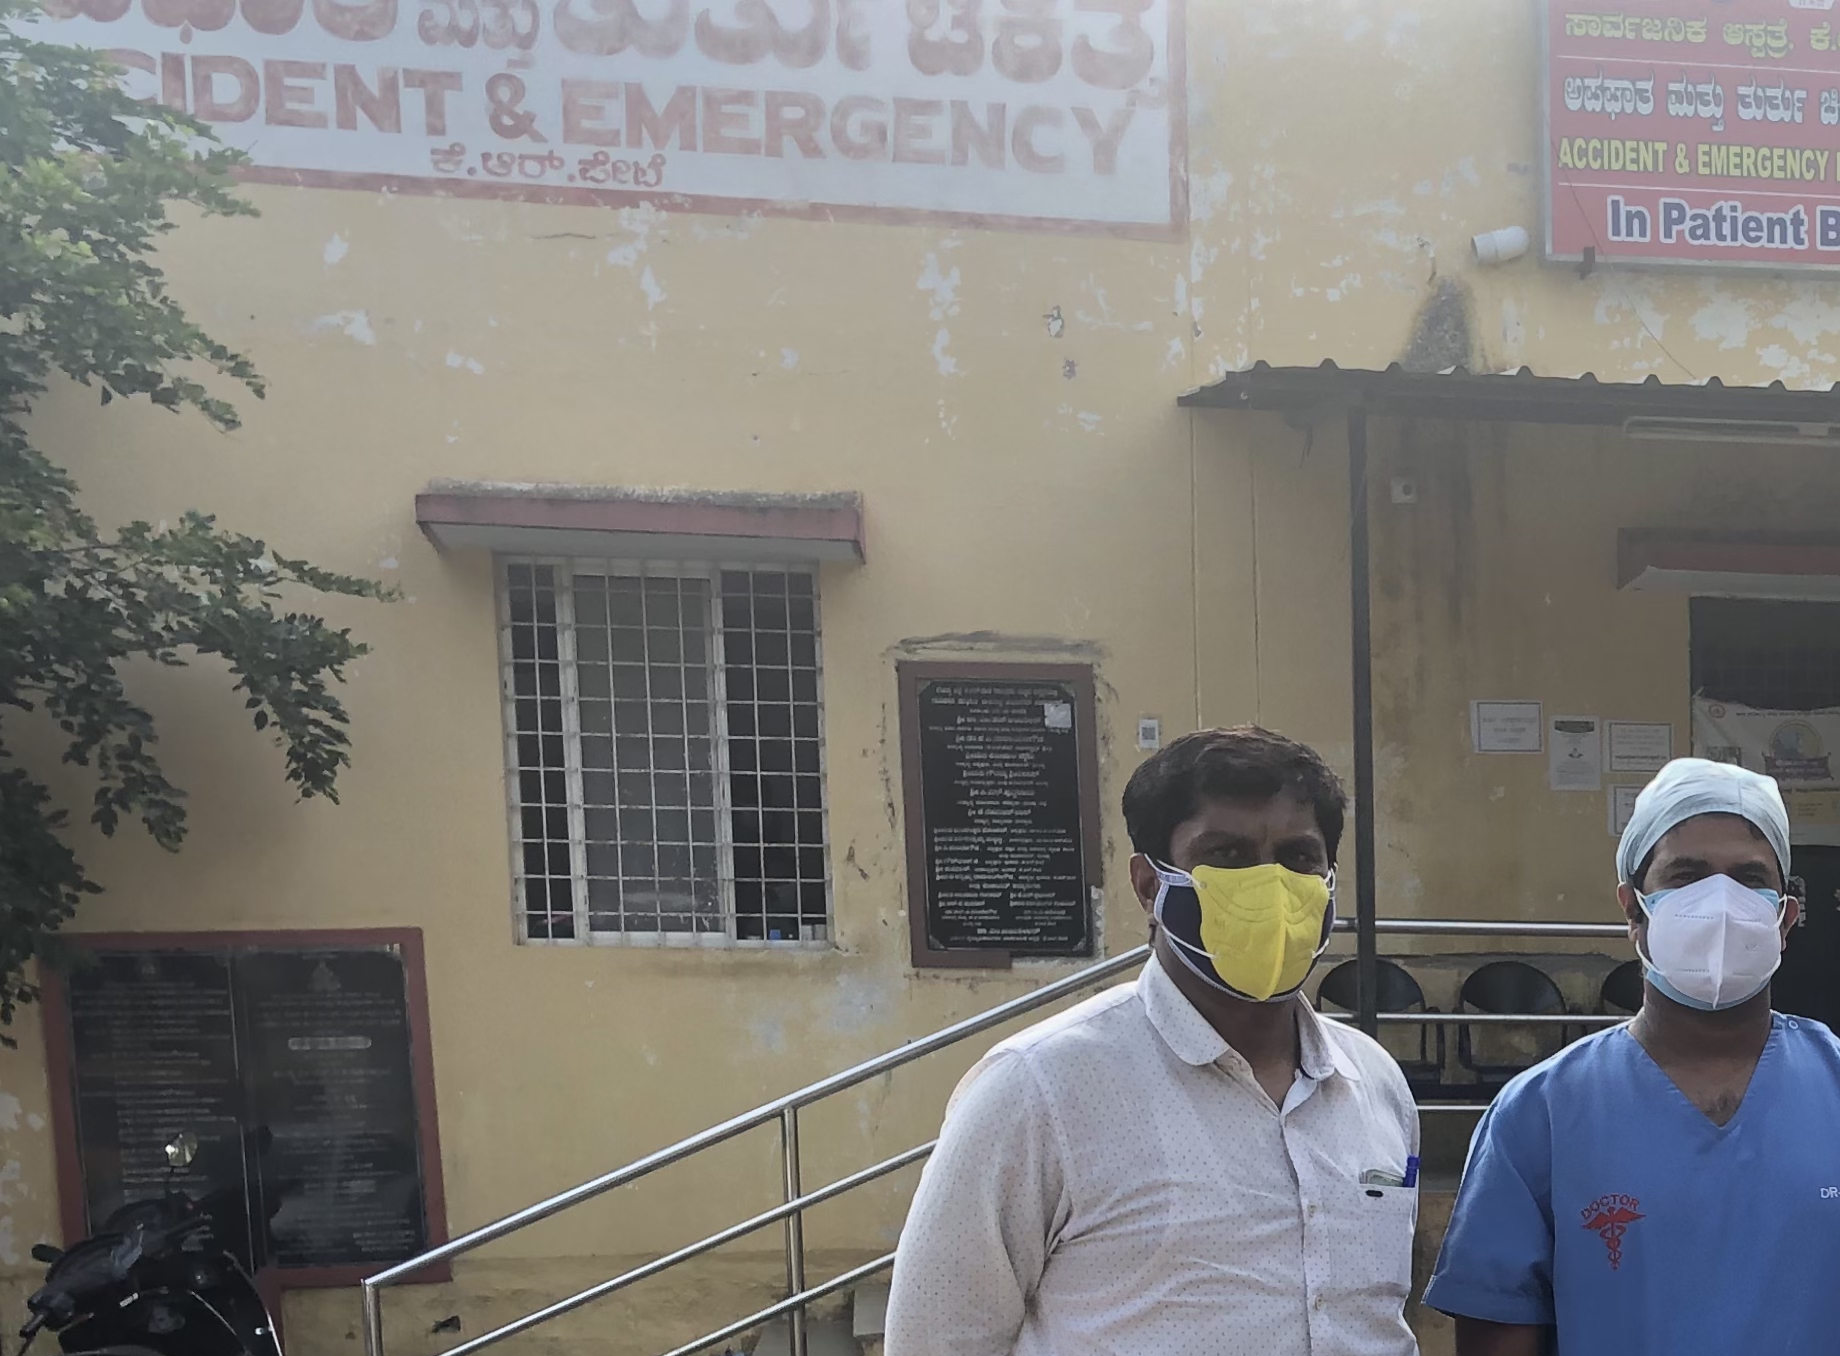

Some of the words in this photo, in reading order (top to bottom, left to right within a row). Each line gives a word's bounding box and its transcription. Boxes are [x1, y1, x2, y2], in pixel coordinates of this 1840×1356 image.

[1565, 12, 1707, 43] ಸಾರ್ವಜನಿಕ
[1564, 66, 1654, 121] ಅಪಘಾತ
[1667, 70, 1725, 132] ಮತ್ತು
[1737, 75, 1807, 124] ತುರ್ತು
[485, 73, 548, 144] &
[561, 77, 1137, 176] EMERGENCY
[1558, 137, 1667, 173] ACCIDENT
[1674, 142, 1689, 174] &
[1697, 143, 1828, 183] EMERGENCY
[1609, 199, 1647, 241] In
[1662, 202, 1805, 246] Patient
[1581, 1193, 1640, 1219] DOCTOR
